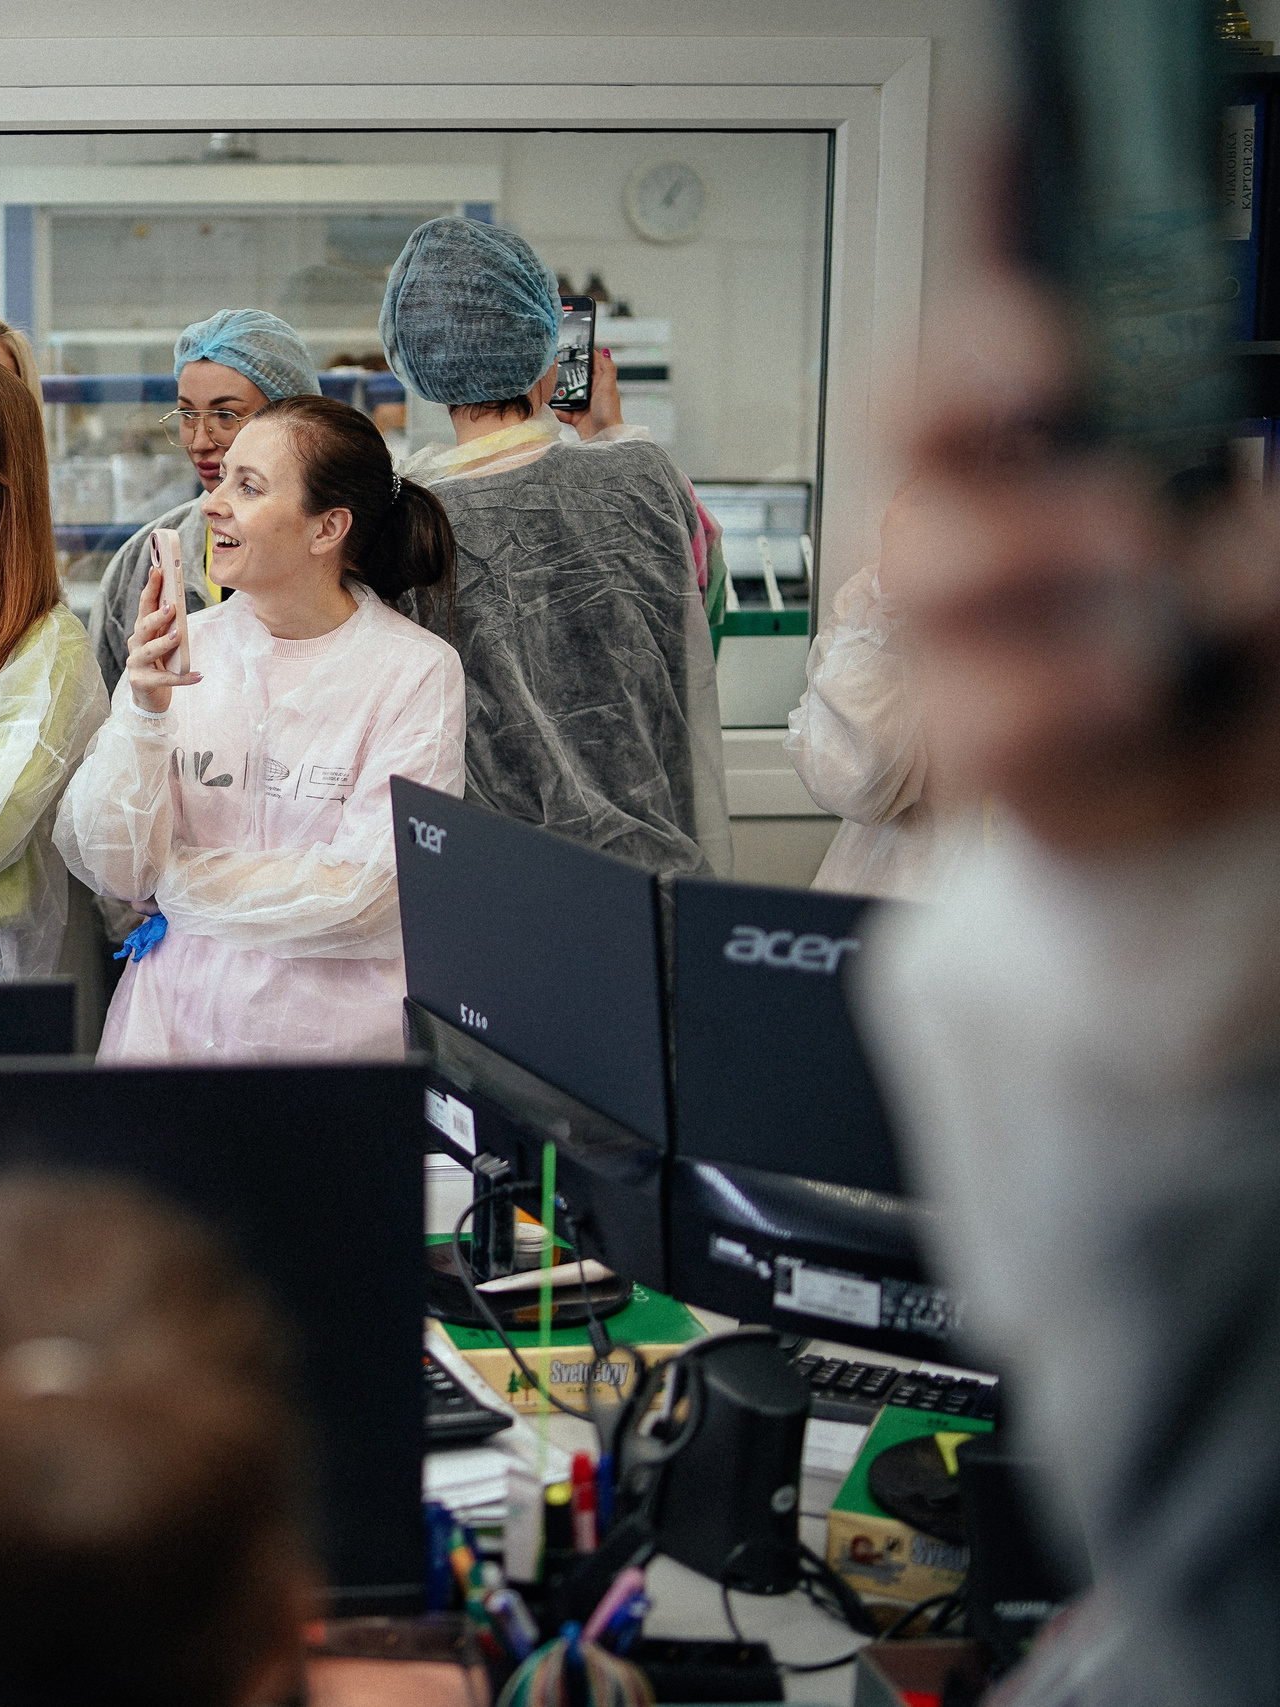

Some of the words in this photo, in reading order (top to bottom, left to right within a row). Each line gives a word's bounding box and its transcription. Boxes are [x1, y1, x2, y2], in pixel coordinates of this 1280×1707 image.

[1243, 128, 1254, 155] 2021
[1225, 132, 1238, 207] УПАКОВКА
[1242, 156, 1254, 210] КАРТОН
[723, 924, 861, 975] acer
[460, 1002, 488, 1030] 5860
